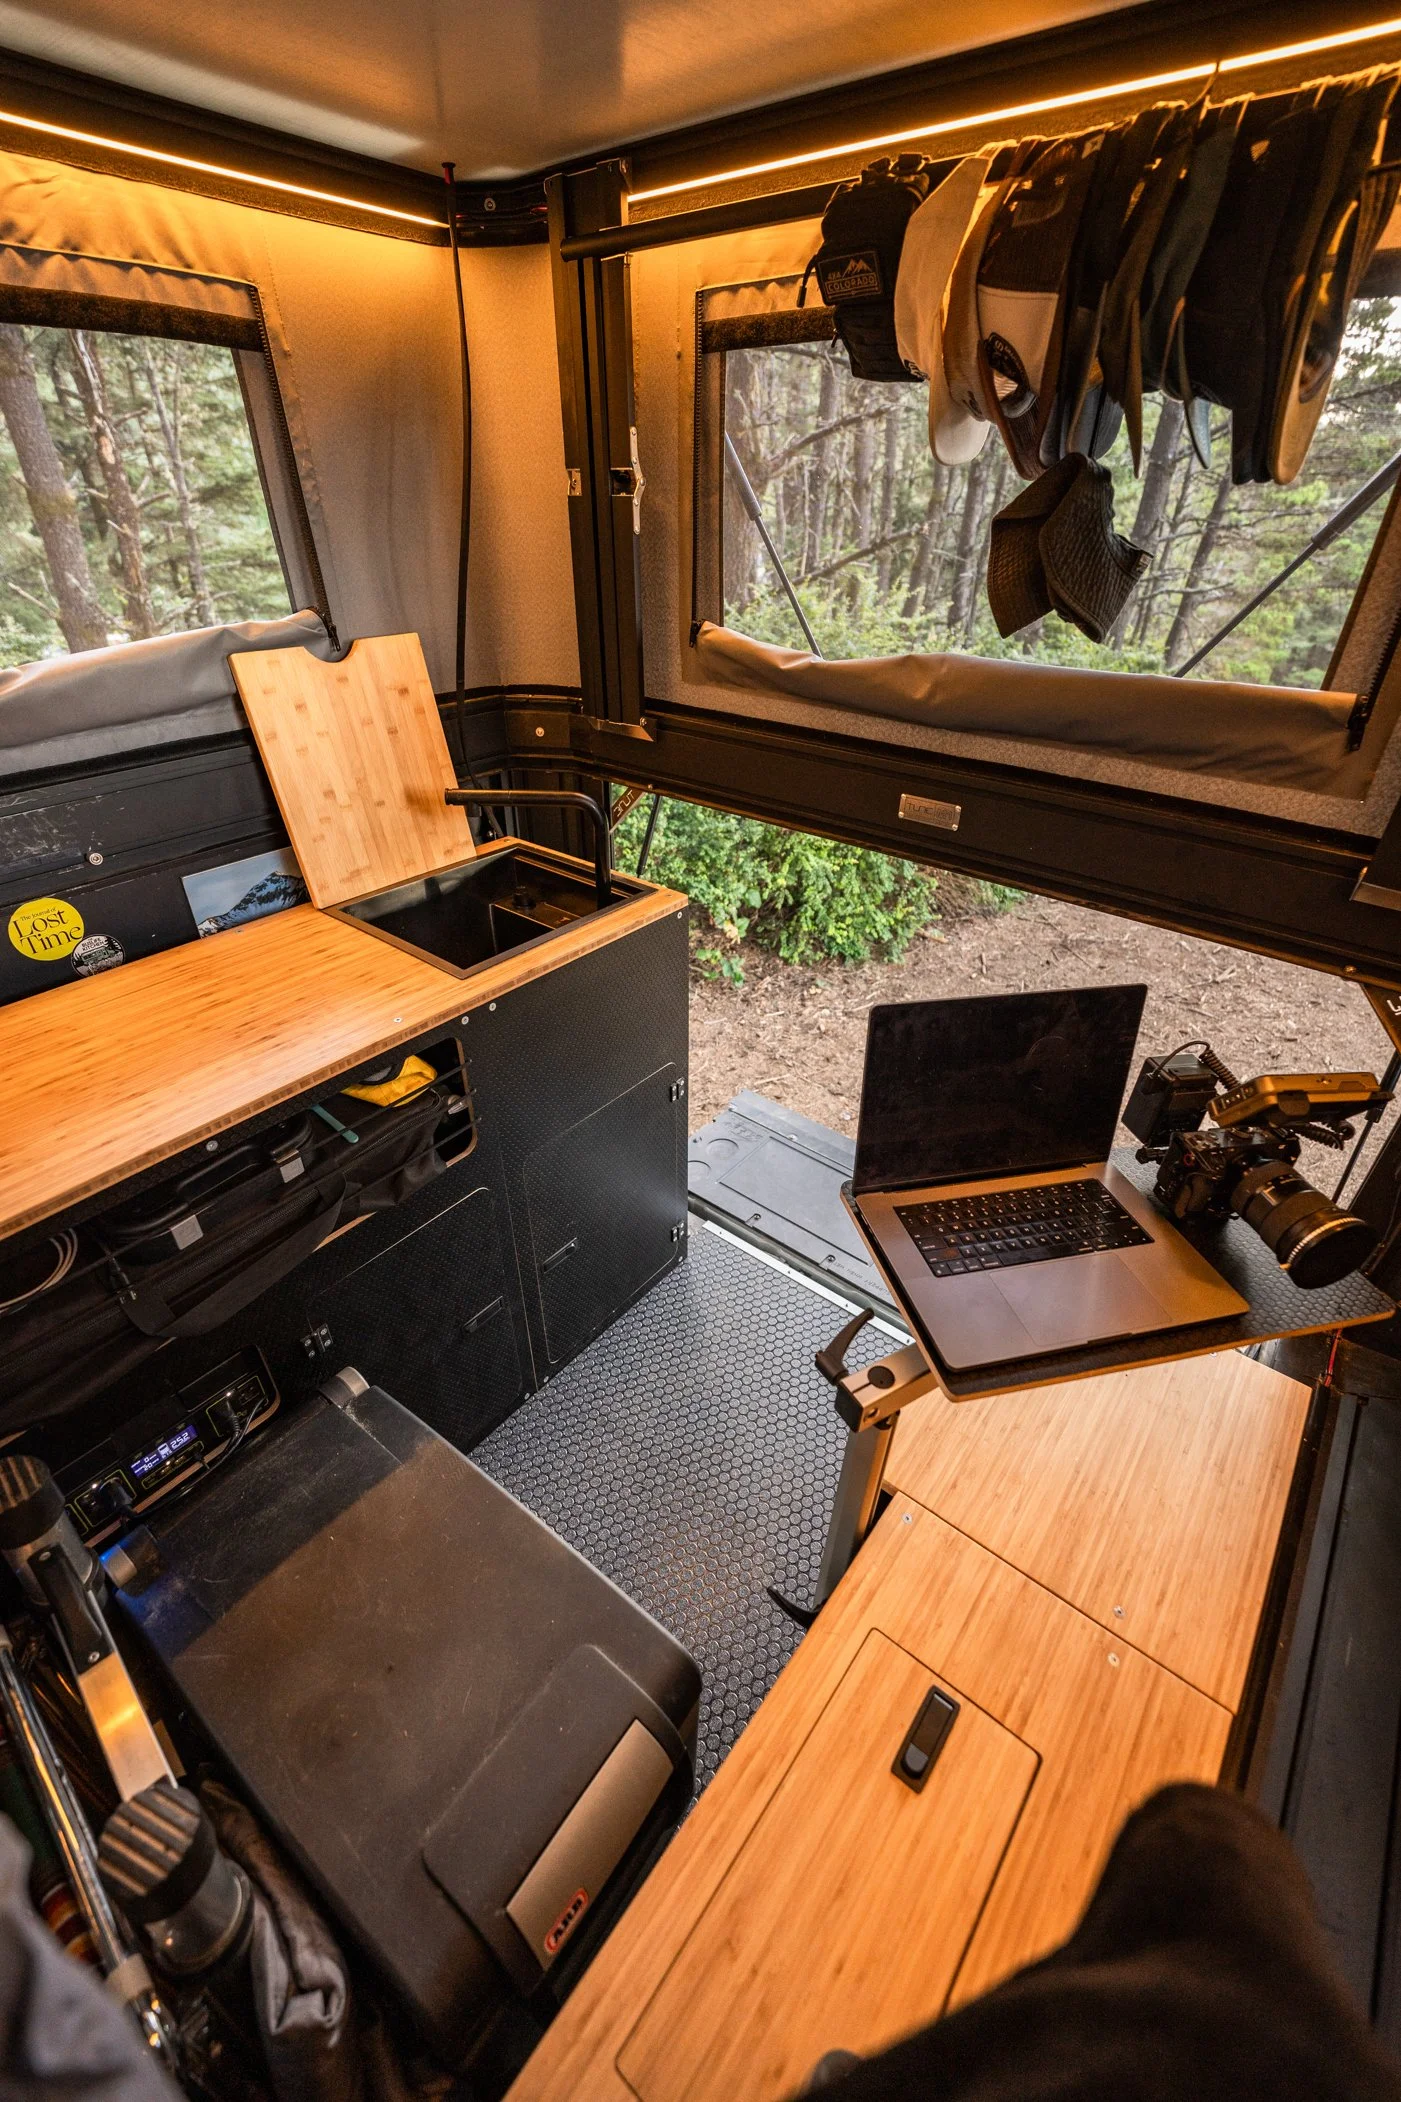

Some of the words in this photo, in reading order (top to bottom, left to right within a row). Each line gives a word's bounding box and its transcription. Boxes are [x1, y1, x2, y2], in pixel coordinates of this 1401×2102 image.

[828, 275, 875, 292] COLORADO
[12, 910, 69, 938] Lost
[31, 909, 50, 920] Journal
[20, 926, 83, 954] Time
[552, 1897, 583, 1943] ARB
